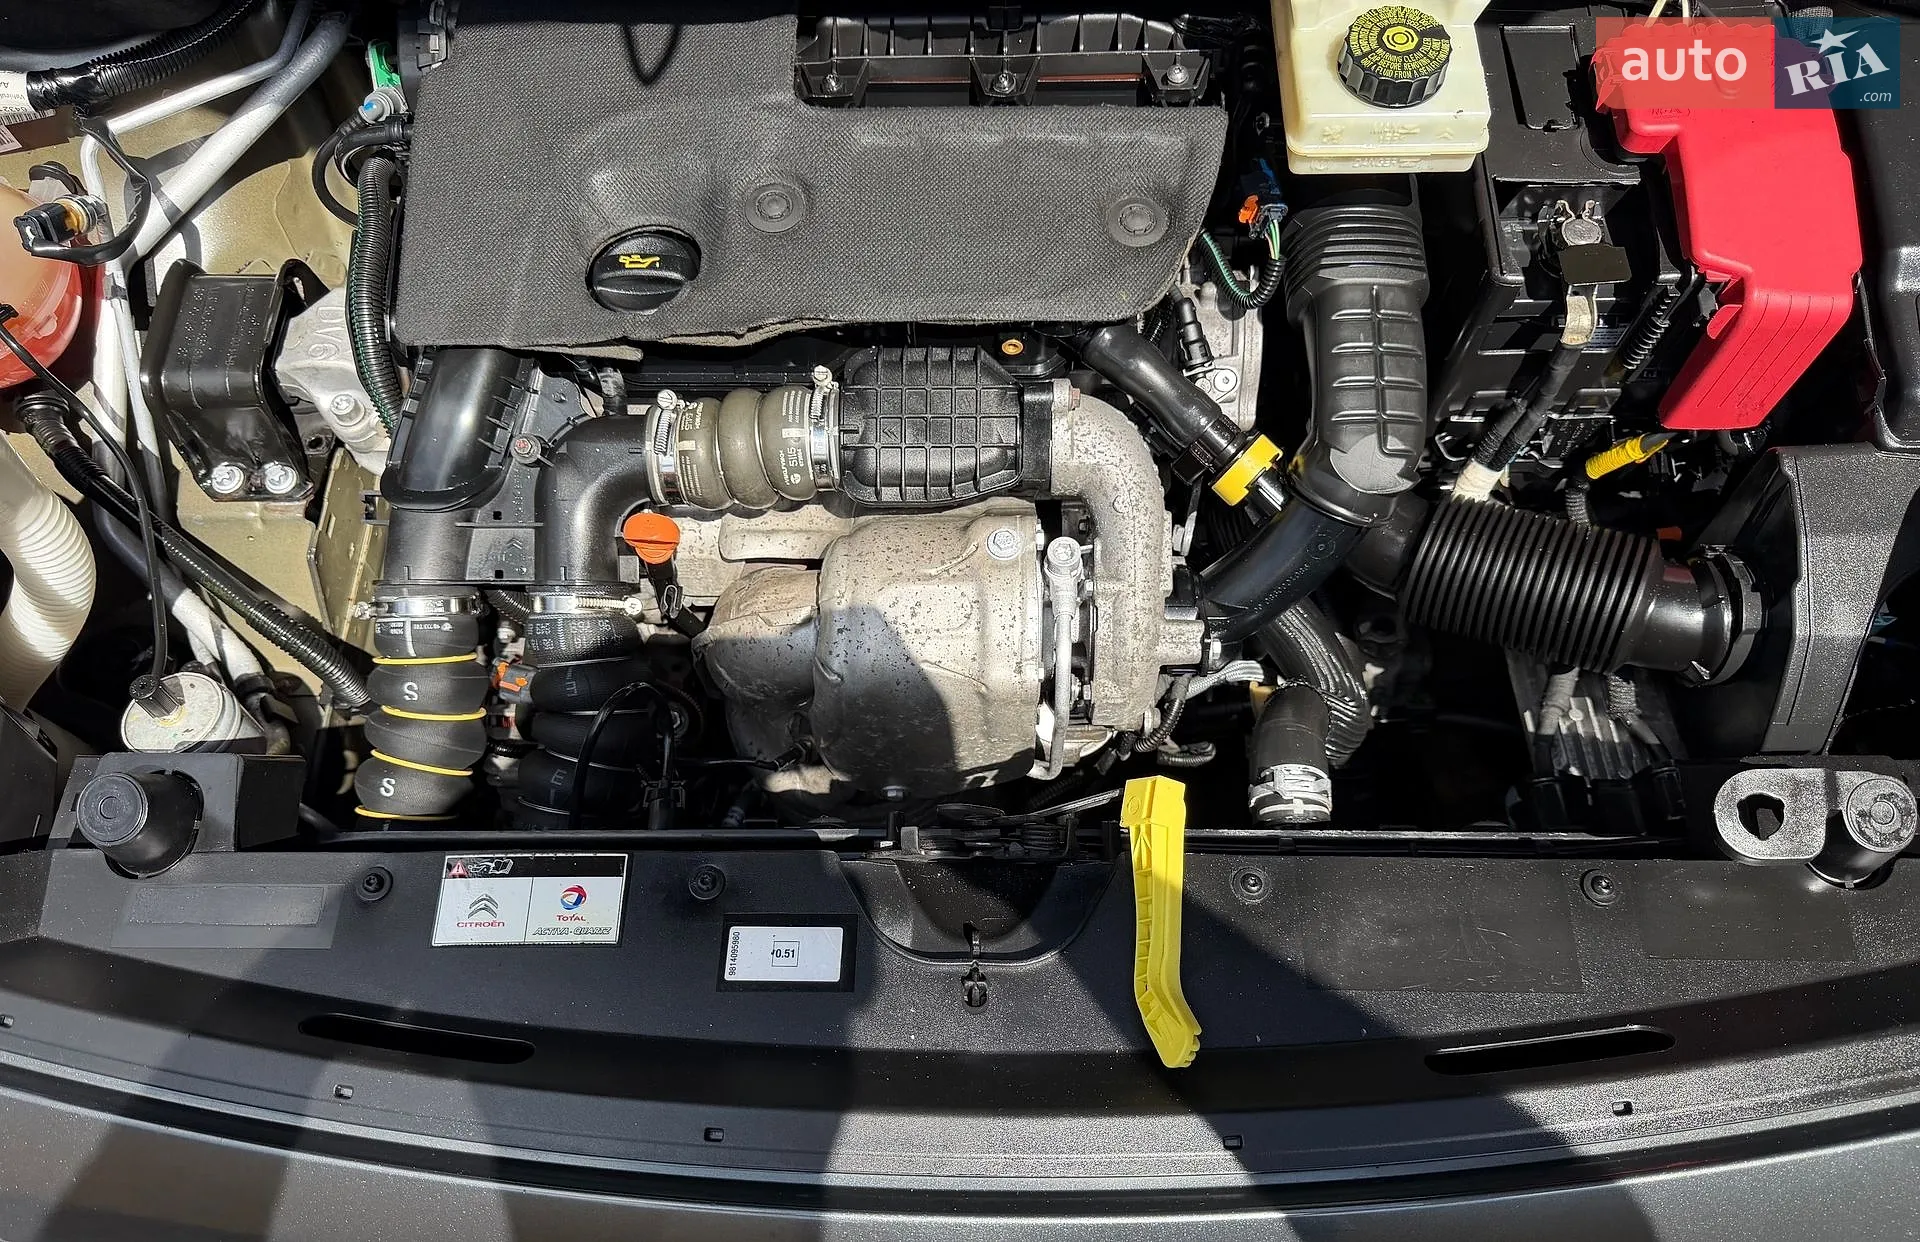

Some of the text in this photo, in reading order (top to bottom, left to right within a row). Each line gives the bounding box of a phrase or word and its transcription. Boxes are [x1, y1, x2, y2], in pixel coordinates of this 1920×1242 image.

[1378, 59, 1401, 70] BEFORE
[1394, 70, 1413, 79] FROM
[404, 682, 418, 701] S
[380, 778, 396, 797] S
[556, 913, 586, 922] TOTAL
[456, 919, 505, 928] CITROËN
[532, 927, 570, 936] ACTIVA
